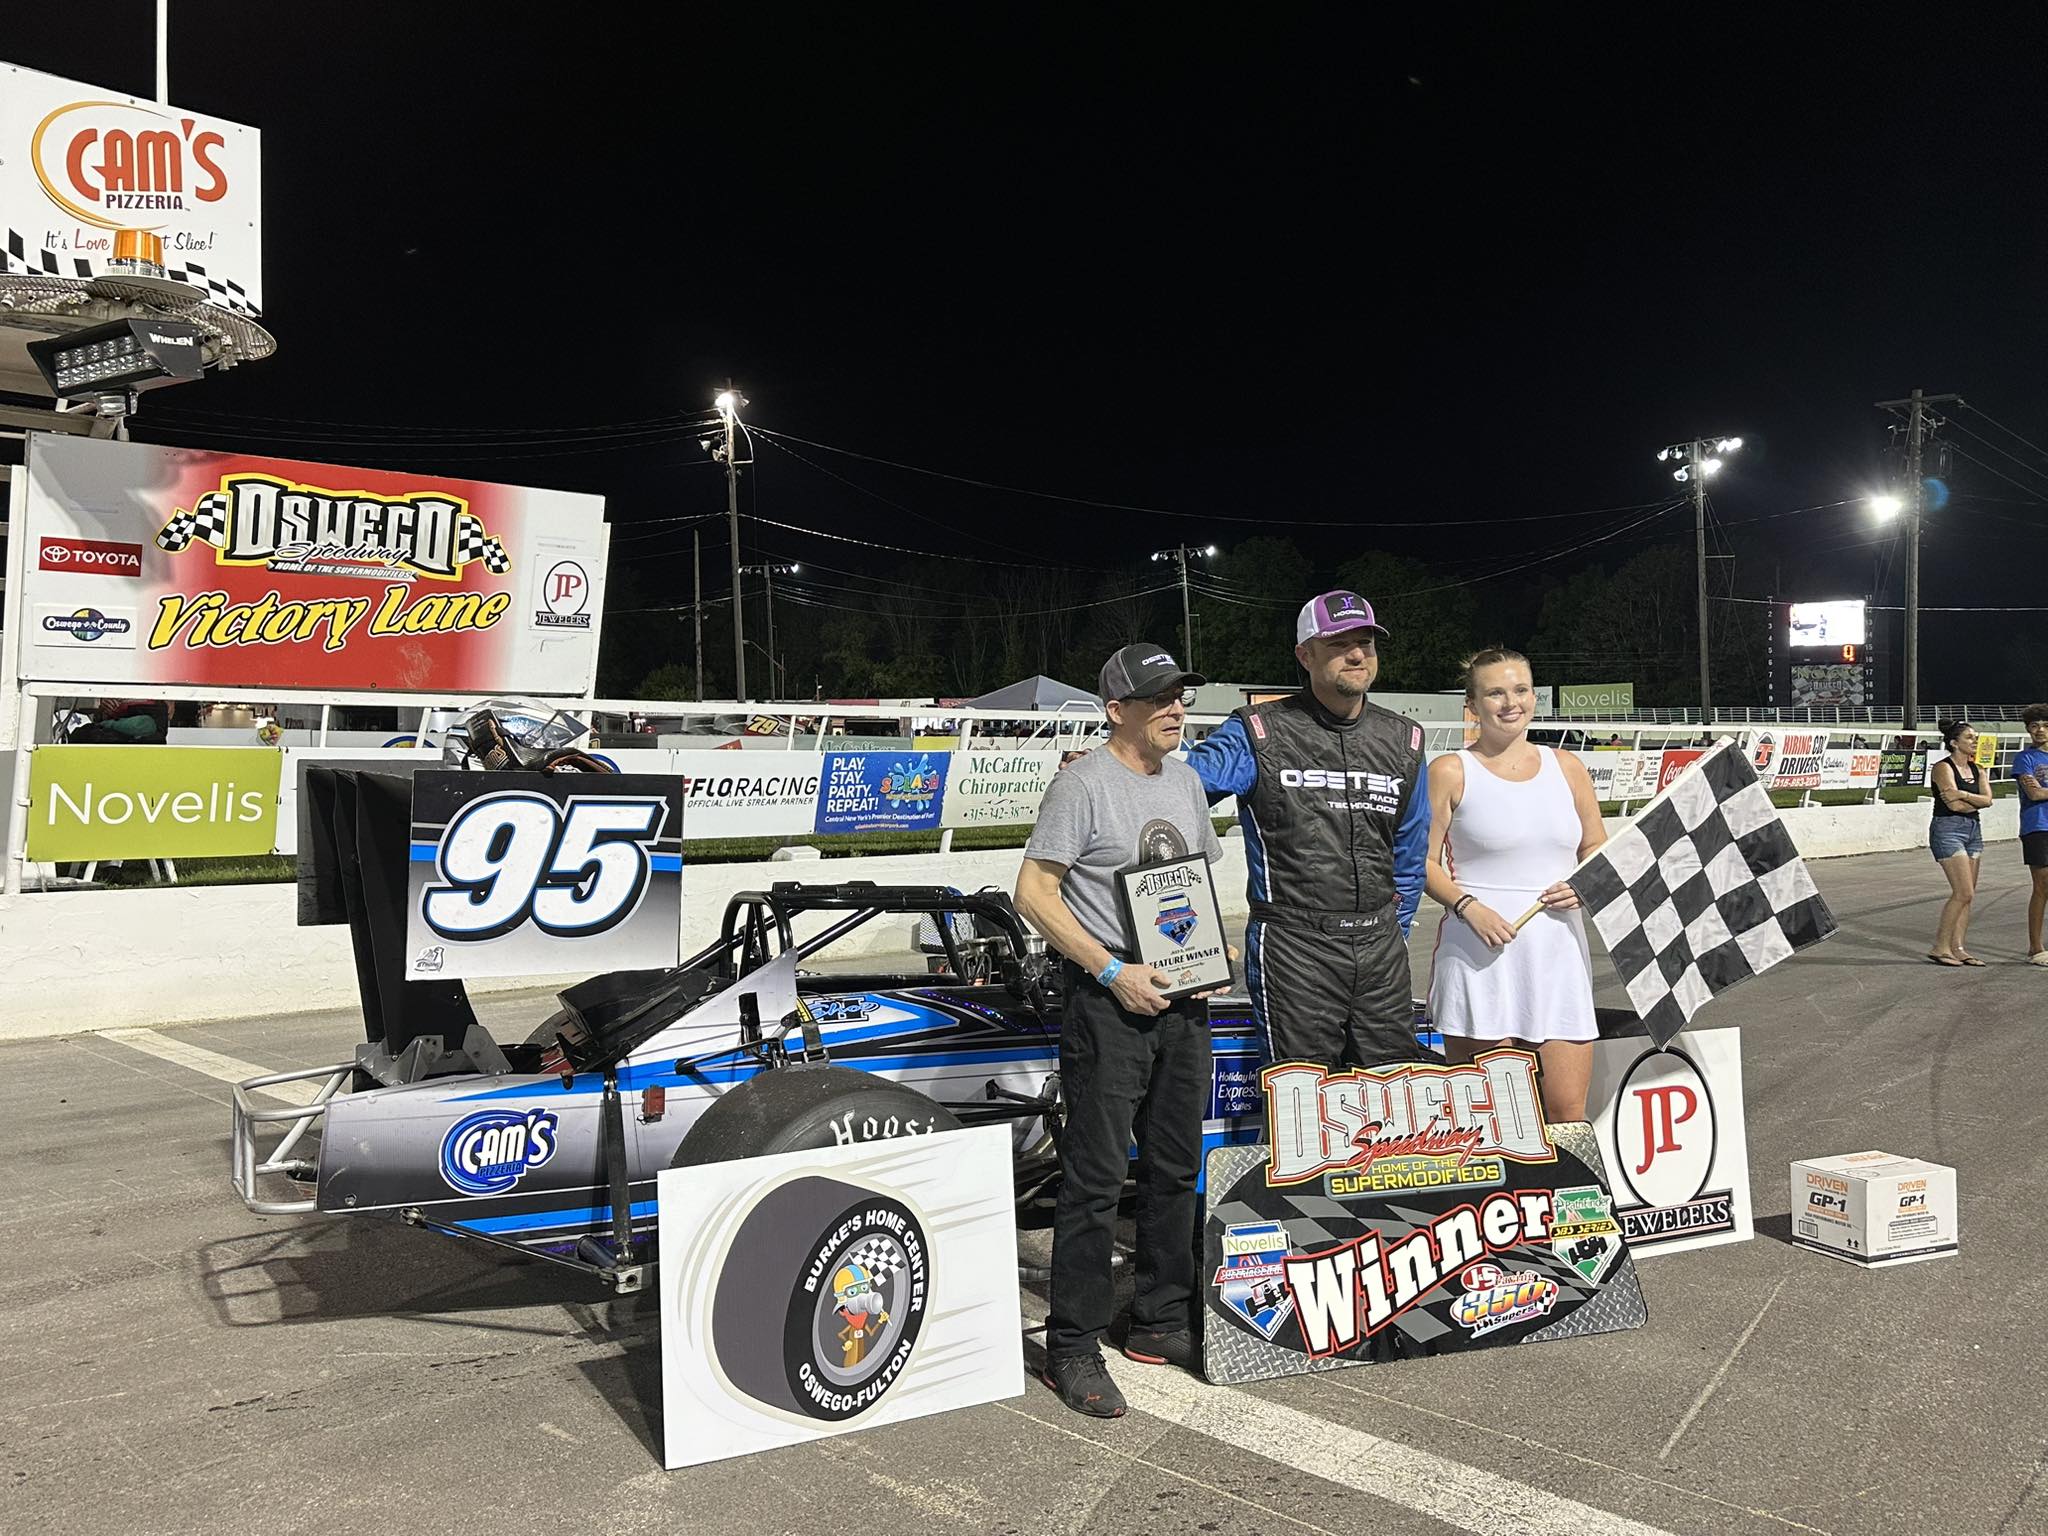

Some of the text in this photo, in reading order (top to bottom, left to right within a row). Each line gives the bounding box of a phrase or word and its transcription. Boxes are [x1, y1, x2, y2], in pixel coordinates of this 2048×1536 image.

[66, 119, 228, 202] CAM'S
[106, 194, 183, 210] PIZZERIA
[46, 228, 110, 250] It's Love
[173, 231, 214, 250] Slice!
[232, 483, 455, 571] OSWEGO
[72, 550, 140, 567] TOYOTA
[275, 541, 411, 566] Speedway
[275, 562, 412, 578] HOME OF THE SUPERMODIFIEDS
[551, 573, 582, 602] JP
[46, 617, 126, 632] Oswego County
[147, 585, 511, 653] Victory Lane
[537, 613, 589, 625] JEWELERS
[1562, 690, 1631, 707] Novelis
[747, 714, 779, 736] 79
[1782, 735, 1812, 755] HIRING
[833, 757, 866, 771] PLAY.
[969, 757, 1043, 776] McCaffrey
[1778, 756, 1821, 774] DRIVERS
[830, 771, 864, 785] STAY.
[880, 774, 940, 794] SPLASH
[958, 777, 1046, 796] Chiropractic
[1280, 769, 1404, 795] OSETEK
[829, 784, 872, 798] PARTY.
[48, 783, 263, 827] Novelis
[687, 797, 814, 808] OFFICIAL LIVE STREAM PARTNER
[826, 798, 879, 812] REPEAT!
[424, 795, 662, 937] 95
[1144, 866, 1191, 896] OSWEGO
[1185, 946, 1220, 962] WINNER
[1218, 1071, 1258, 1083] Holiday In
[1218, 1084, 1257, 1101] Expres
[1224, 1102, 1252, 1111] & Suites
[1269, 1056, 1550, 1177] OSWEGO
[829, 1108, 935, 1146] Hoosi
[1633, 1085, 1697, 1175] JP
[461, 1115, 552, 1174] CAM'S
[1345, 1115, 1484, 1175] Speedway
[480, 1161, 521, 1177] PIZZERIA
[1372, 1158, 1457, 1174] HOME OF THE
[1331, 1164, 1500, 1194] SUPERMODIFIEDS
[1806, 1173, 1848, 1192] DRIVEN
[1897, 1179, 1926, 1191] DRIVEN
[1809, 1192, 1846, 1212] GP-1
[1900, 1194, 1925, 1207] GP-1
[1621, 1200, 1729, 1238] EWELERS
[1554, 1225, 1575, 1236] SBS
[1227, 1235, 1284, 1253] Novelis
[804, 1209, 926, 1313] BURKE'S HOME CENTER
[1220, 1265, 1284, 1280] SUPERMODIFIE
[1287, 1192, 1552, 1356] Winner
[1462, 1281, 1546, 1325] 350
[798, 1339, 912, 1412] OSWEGO-FULTON
